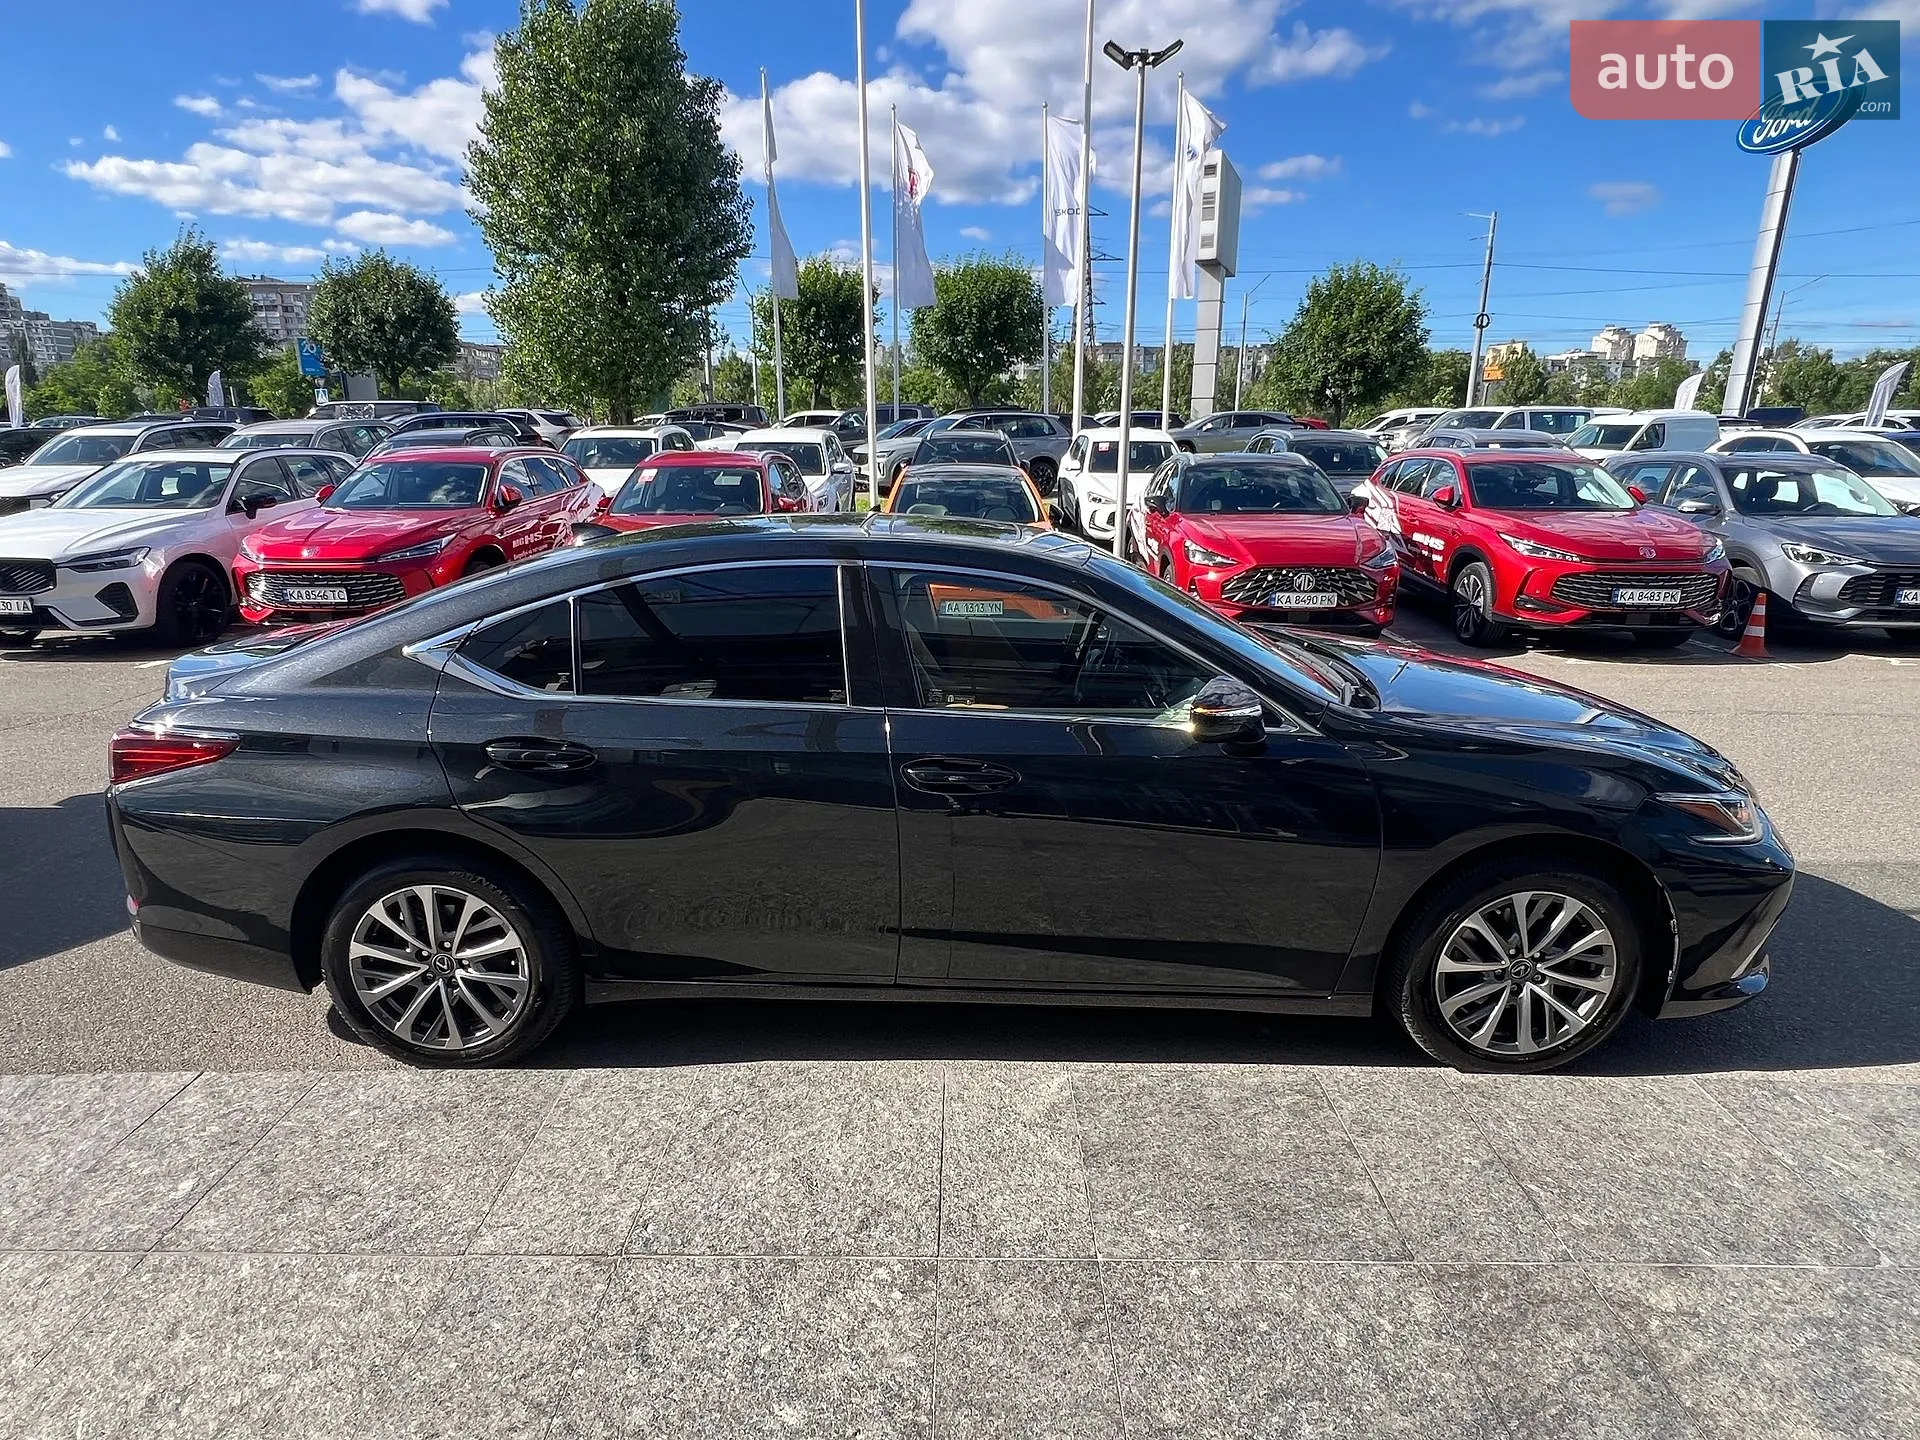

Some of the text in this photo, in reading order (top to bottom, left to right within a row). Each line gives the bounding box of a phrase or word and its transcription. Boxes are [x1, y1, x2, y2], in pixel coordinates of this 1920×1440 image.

[1752, 91, 1820, 146] Ford
[1296, 574, 1314, 591] MG
[288, 589, 304, 600] KA
[304, 589, 328, 600] 8546
[1276, 594, 1335, 605] KA 8490 PK
[1619, 591, 1678, 603] KA 8483 PK
[1903, 591, 1918, 601] KA
[962, 602, 985, 613] 1313
[988, 602, 1002, 613] YN
